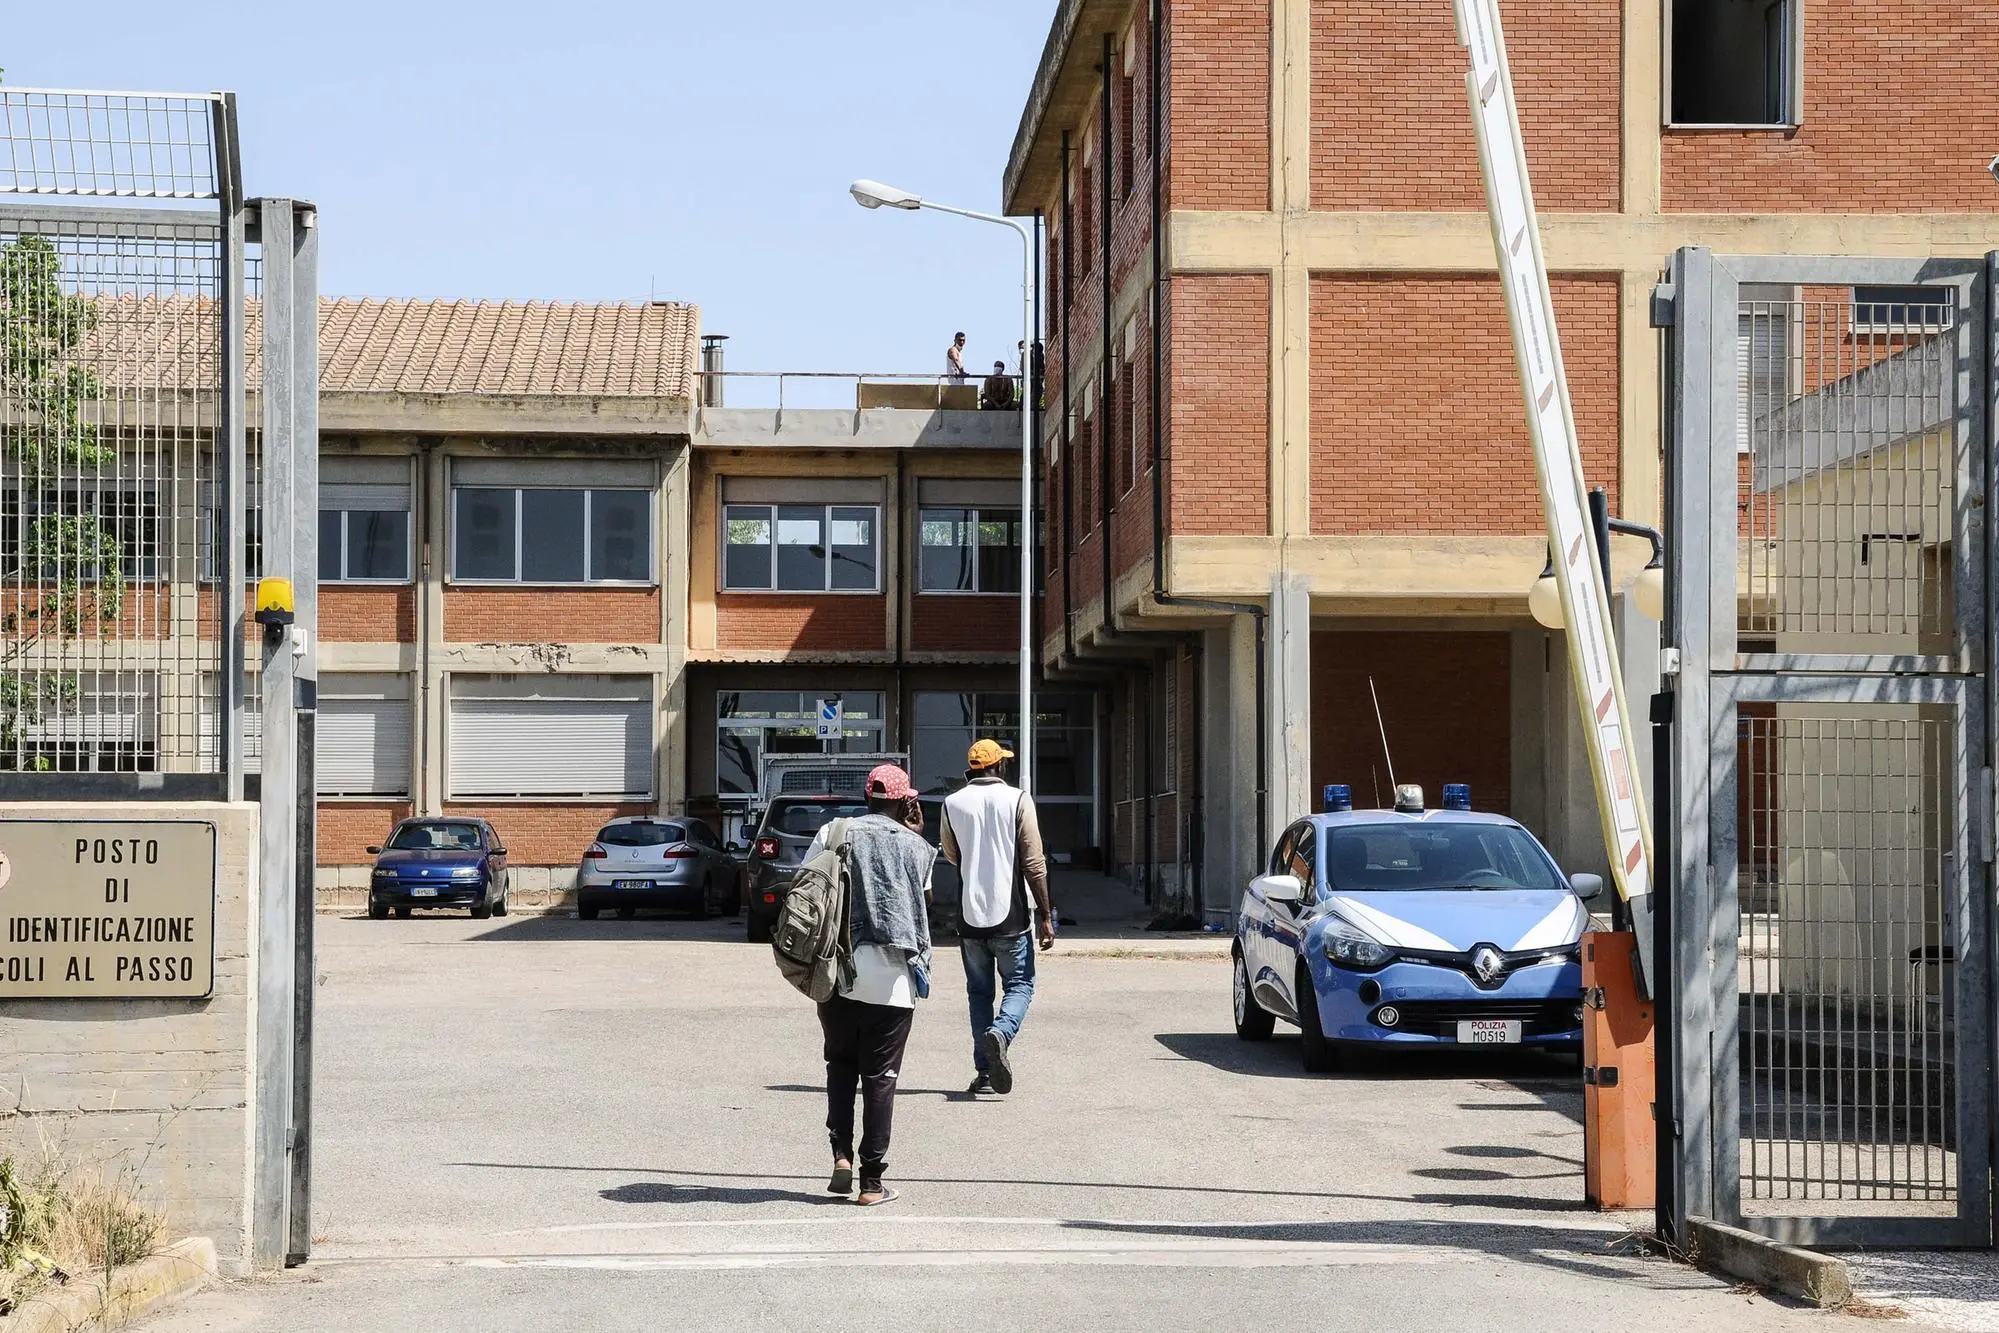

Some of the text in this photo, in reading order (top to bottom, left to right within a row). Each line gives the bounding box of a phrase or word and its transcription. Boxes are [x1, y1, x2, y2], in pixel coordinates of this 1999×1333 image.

[75, 838, 158, 864] POSTO
[105, 878, 129, 903] DI
[9, 917, 195, 942] IDENTIFICAZIONE
[65, 956, 95, 981] AL
[116, 956, 193, 981] PASSO
[1471, 1021, 1506, 1029] POLIZIA
